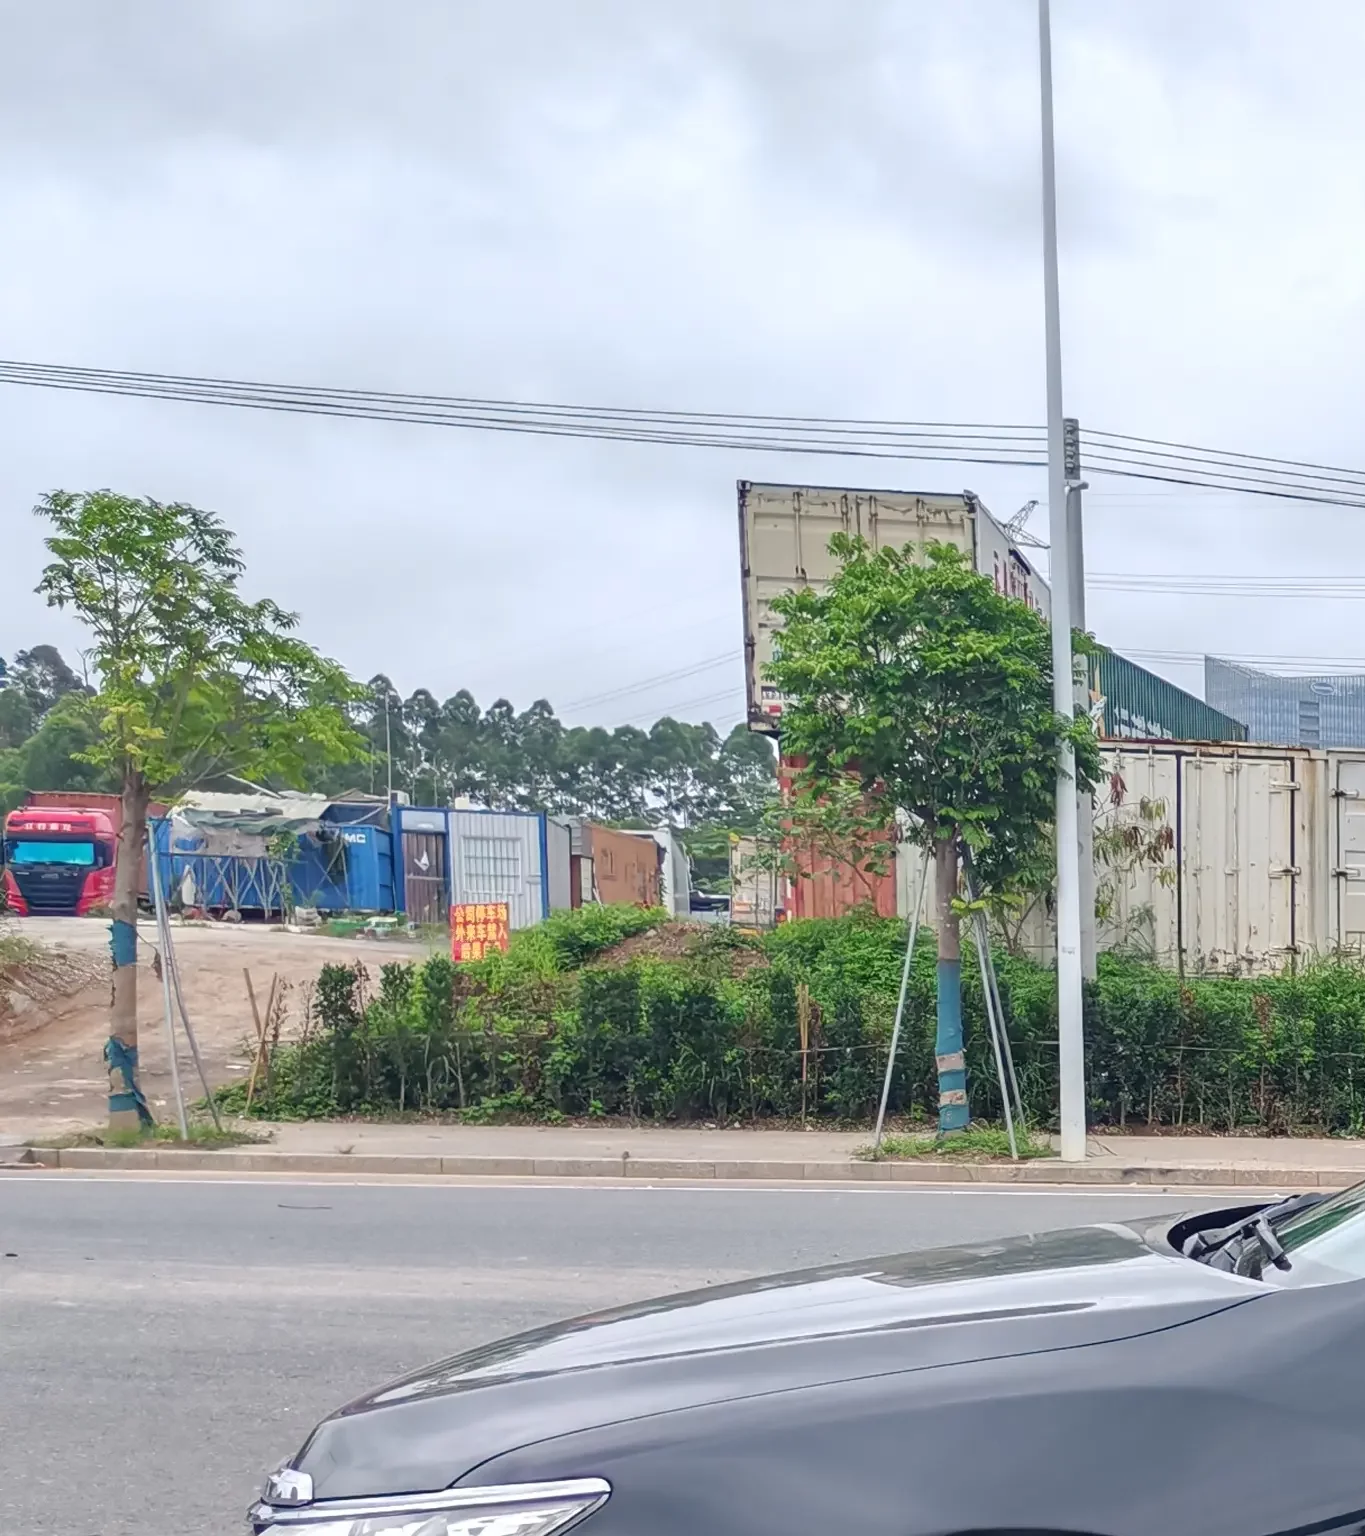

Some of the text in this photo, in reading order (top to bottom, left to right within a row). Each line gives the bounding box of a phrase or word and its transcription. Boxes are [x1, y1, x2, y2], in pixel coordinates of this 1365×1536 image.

[454, 904, 507, 922] 公司停车场
